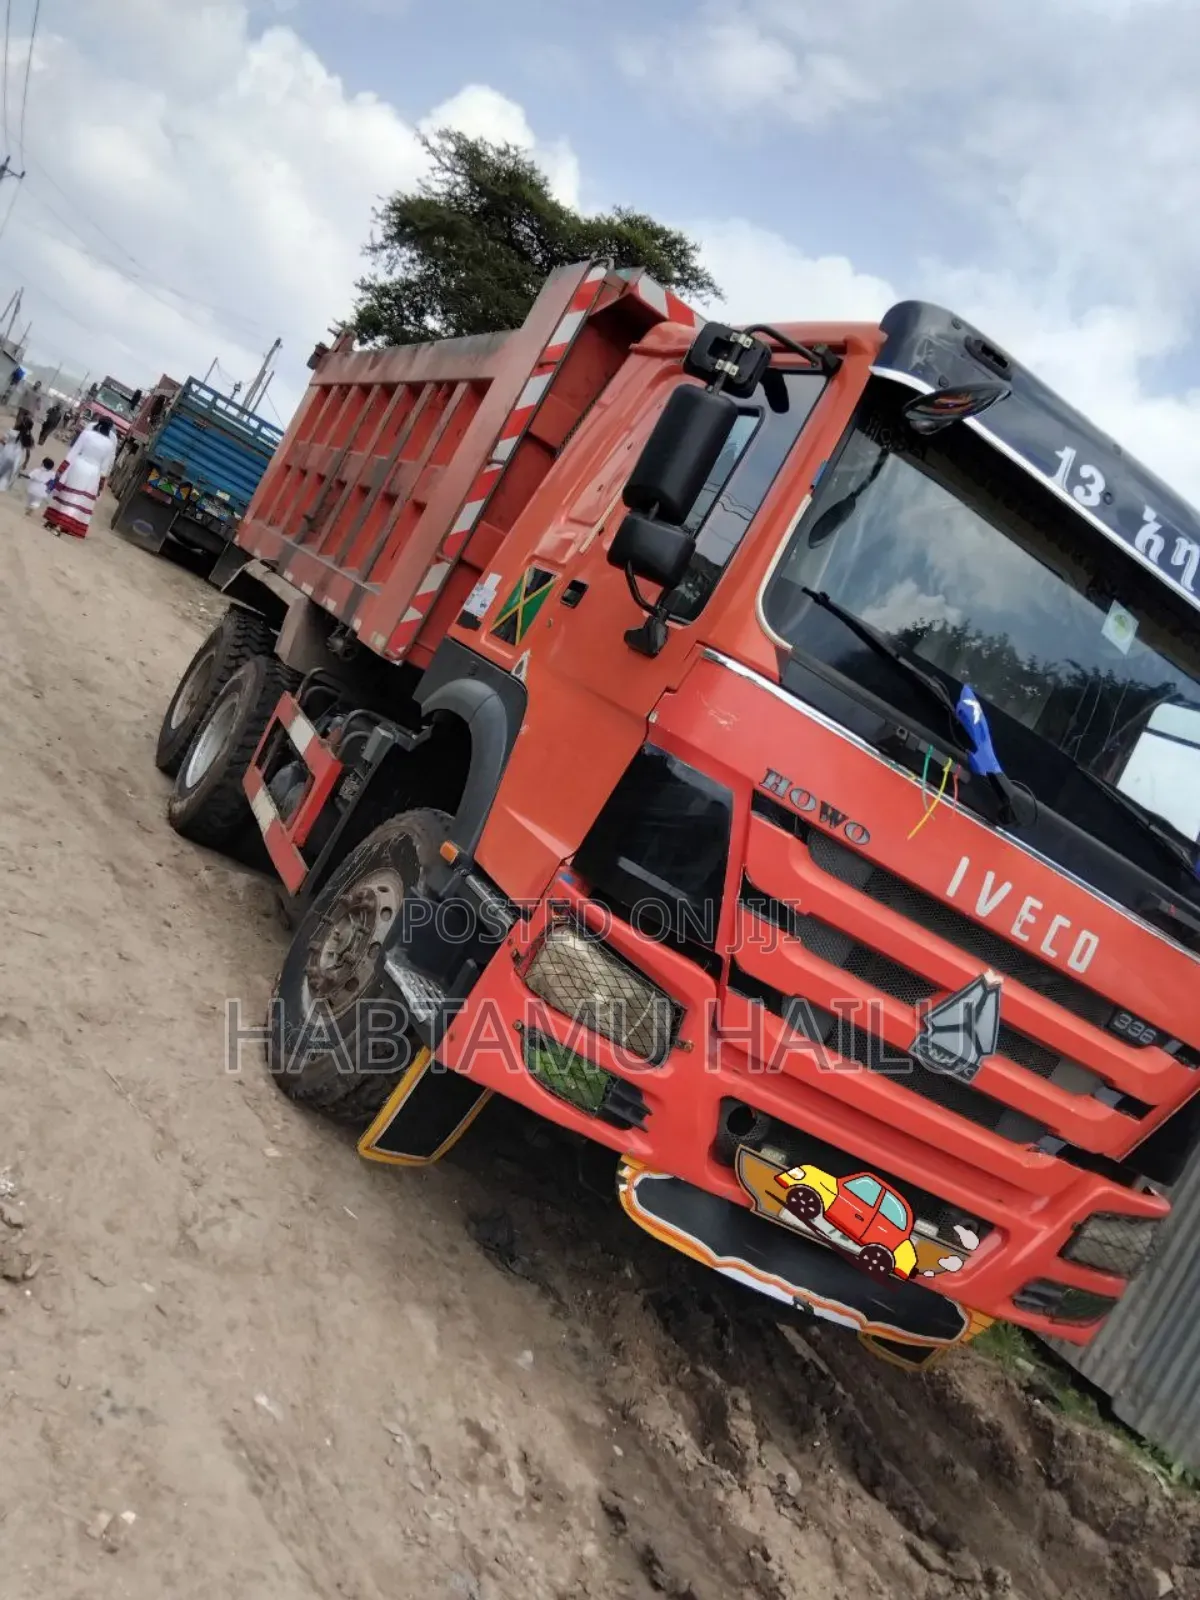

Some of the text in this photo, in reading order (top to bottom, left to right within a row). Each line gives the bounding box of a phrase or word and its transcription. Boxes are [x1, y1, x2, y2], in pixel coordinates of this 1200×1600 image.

[1049, 446, 1106, 506] 13
[758, 767, 871, 846] HOWO
[946, 856, 1100, 974] IVECO
